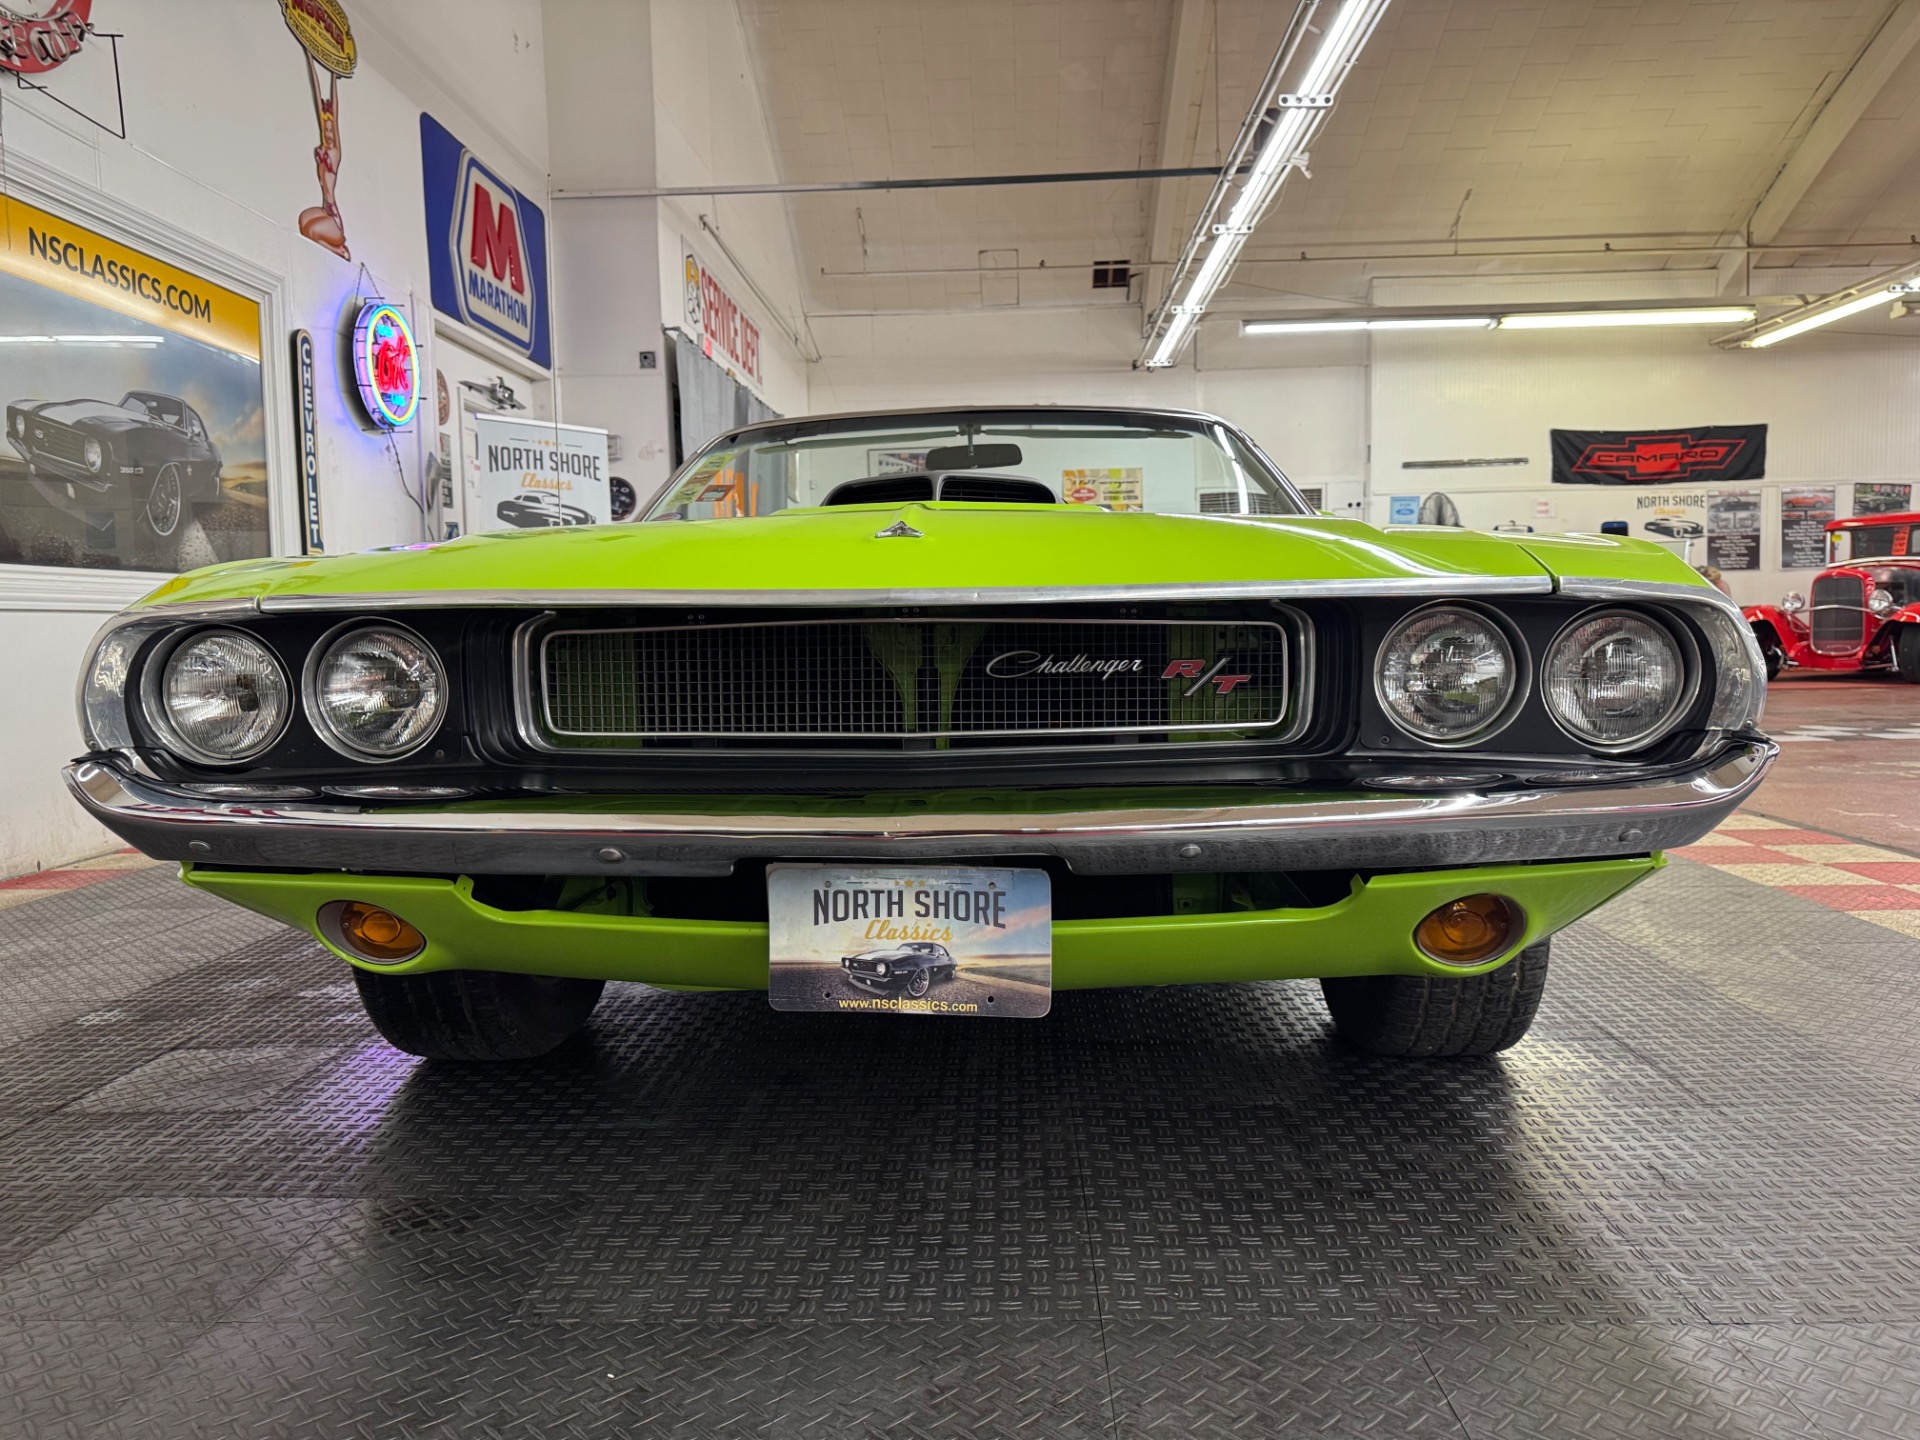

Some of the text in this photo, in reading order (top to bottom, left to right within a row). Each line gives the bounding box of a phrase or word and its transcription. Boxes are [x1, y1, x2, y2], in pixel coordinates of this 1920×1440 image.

[470, 182, 525, 296] M
[28, 227, 211, 323] NSCLASSICS.COM
[468, 269, 528, 328] MARATHON
[701, 267, 739, 364] SERVICE
[301, 342, 319, 544] CHEVROLET
[1597, 449, 1719, 463] CAMARO
[488, 445, 601, 482] NORTH SHORE
[520, 471, 574, 491] Classics
[1637, 494, 1706, 510] NORTH SHORE
[985, 650, 1252, 697] Challenger R/T
[813, 889, 1006, 929] NORTH SHORE
[864, 919, 954, 942] Classics
[838, 996, 978, 1013] www.nsclassics.com
